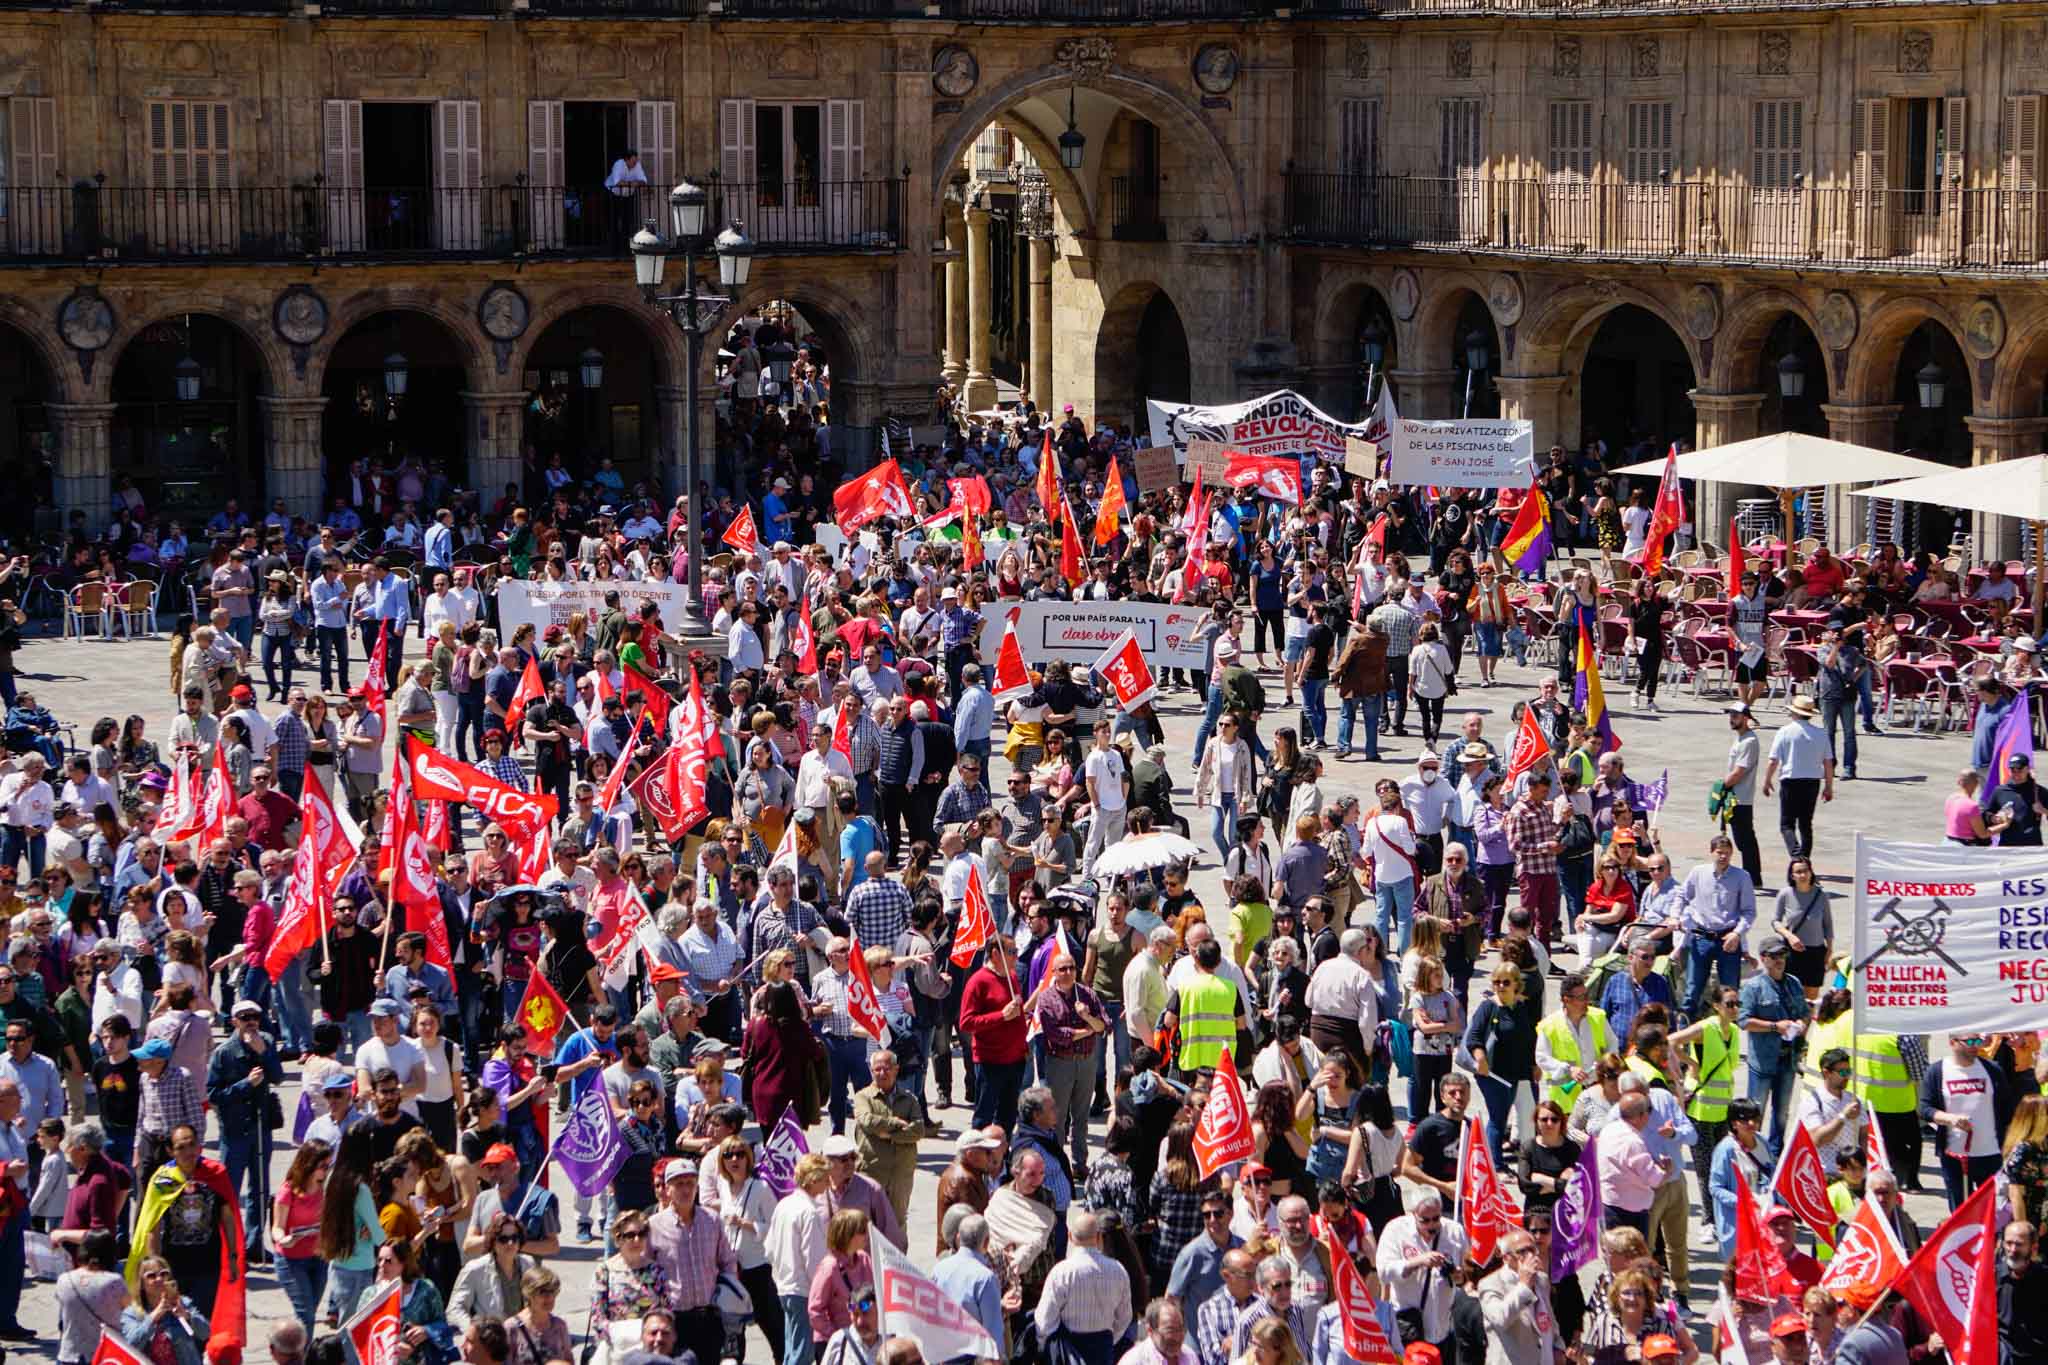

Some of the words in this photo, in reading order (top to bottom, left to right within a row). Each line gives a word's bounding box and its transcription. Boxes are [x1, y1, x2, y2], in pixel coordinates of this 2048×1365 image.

[1249, 441, 1289, 456] FRENTE
[1409, 440, 1423, 450] DE
[1425, 440, 1444, 450] LAS
[1446, 442, 1495, 451] PISCINAS
[1497, 443, 1514, 452] DEL
[1444, 457, 1465, 466] SAN
[1468, 455, 1495, 467] JOSÉ
[589, 590, 630, 599] TRAJO
[1052, 614, 1071, 622] POR
[1072, 614, 1085, 622] UN
[1087, 613, 1107, 623] PAÍS
[1109, 615, 1133, 624] PARA
[1135, 616, 1147, 624] LA
[1062, 627, 1094, 641] clase
[1110, 657, 1138, 697] PSOE
[1866, 879, 1976, 896] BARRENDEROS
[1866, 965, 1887, 981] EN
[1890, 966, 1947, 981] LUCHA
[1889, 984, 1947, 993] NUESTROS
[1868, 995, 1948, 1007] DERECHOS
